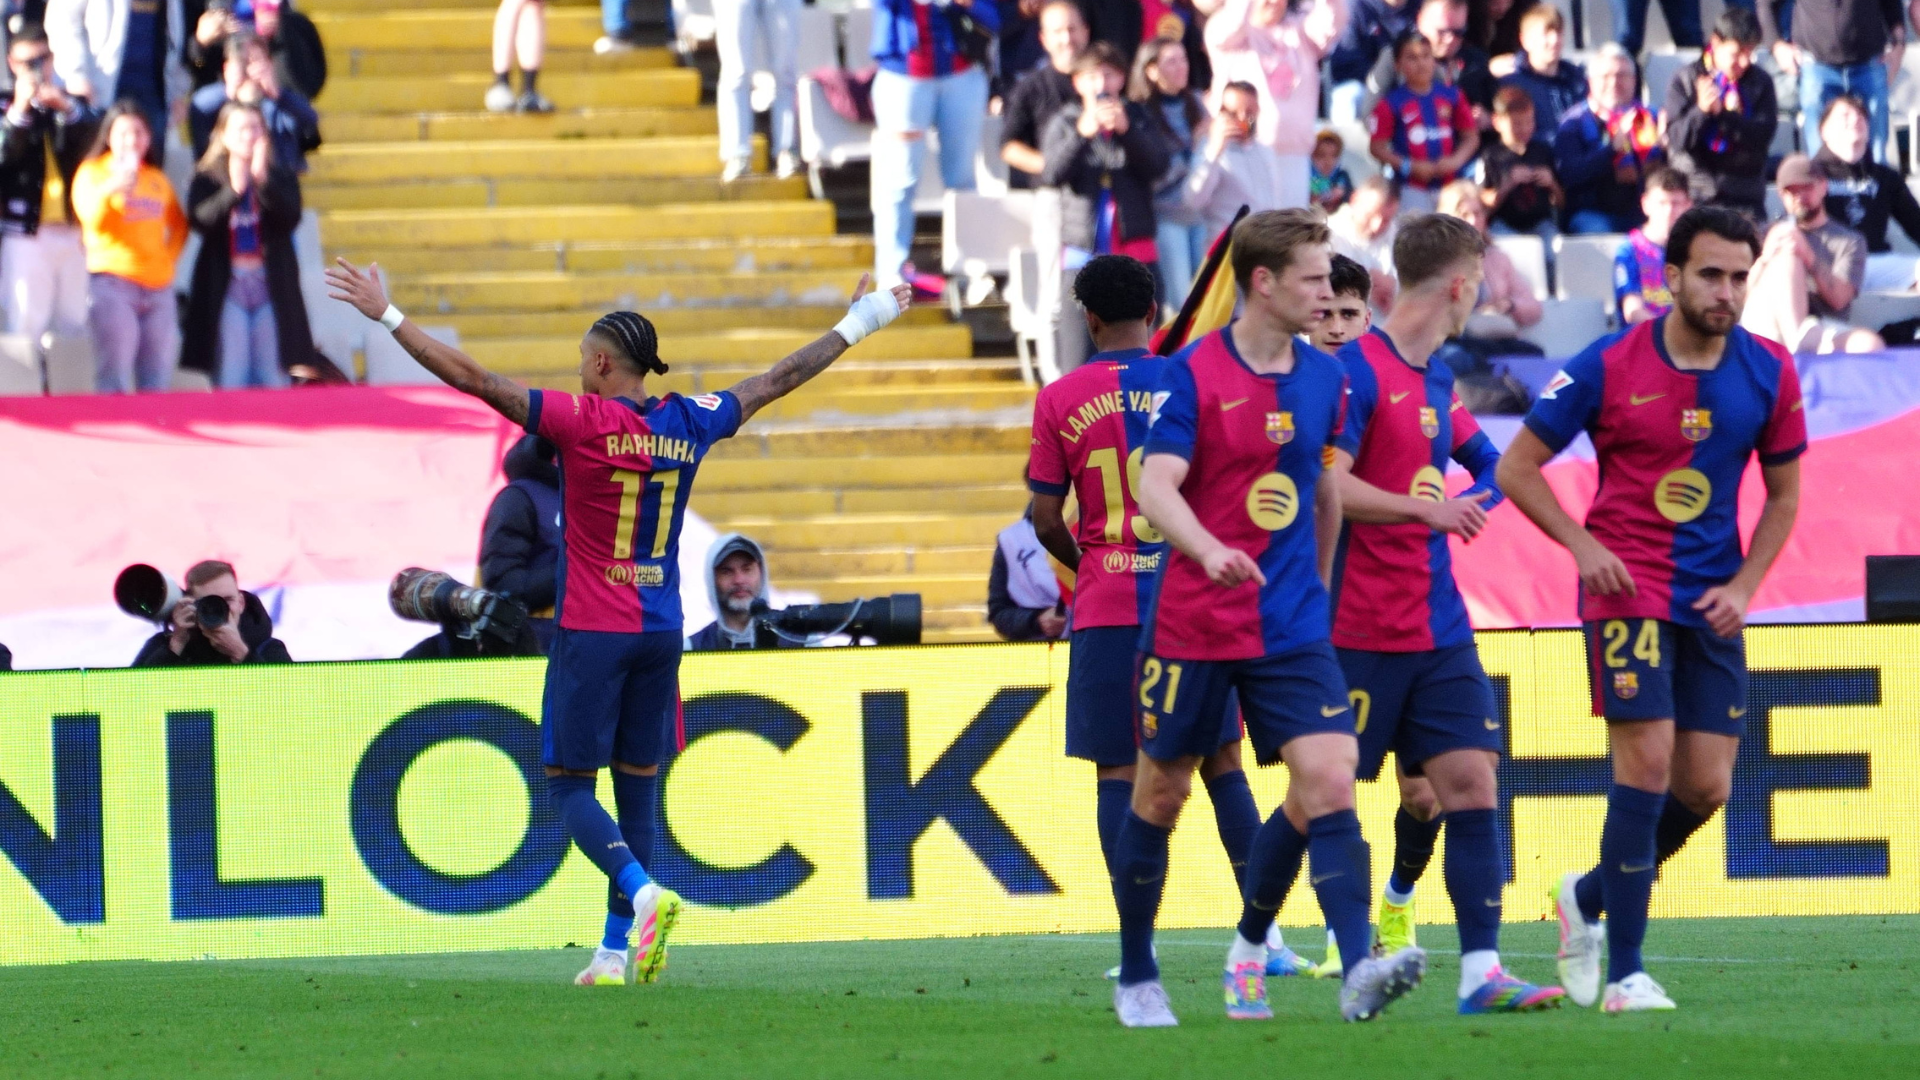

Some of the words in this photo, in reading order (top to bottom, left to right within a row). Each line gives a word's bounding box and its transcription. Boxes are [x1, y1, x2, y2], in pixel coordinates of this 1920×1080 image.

[1059, 390, 1126, 444] LAMINE
[1129, 390, 1152, 413] YA
[606, 433, 697, 464] RAPHINHA
[610, 468, 680, 559] 11
[1131, 552, 1162, 563] UNHC
[1131, 561, 1160, 571] ACN
[1603, 618, 1661, 668] 24
[1140, 657, 1183, 714] 21
